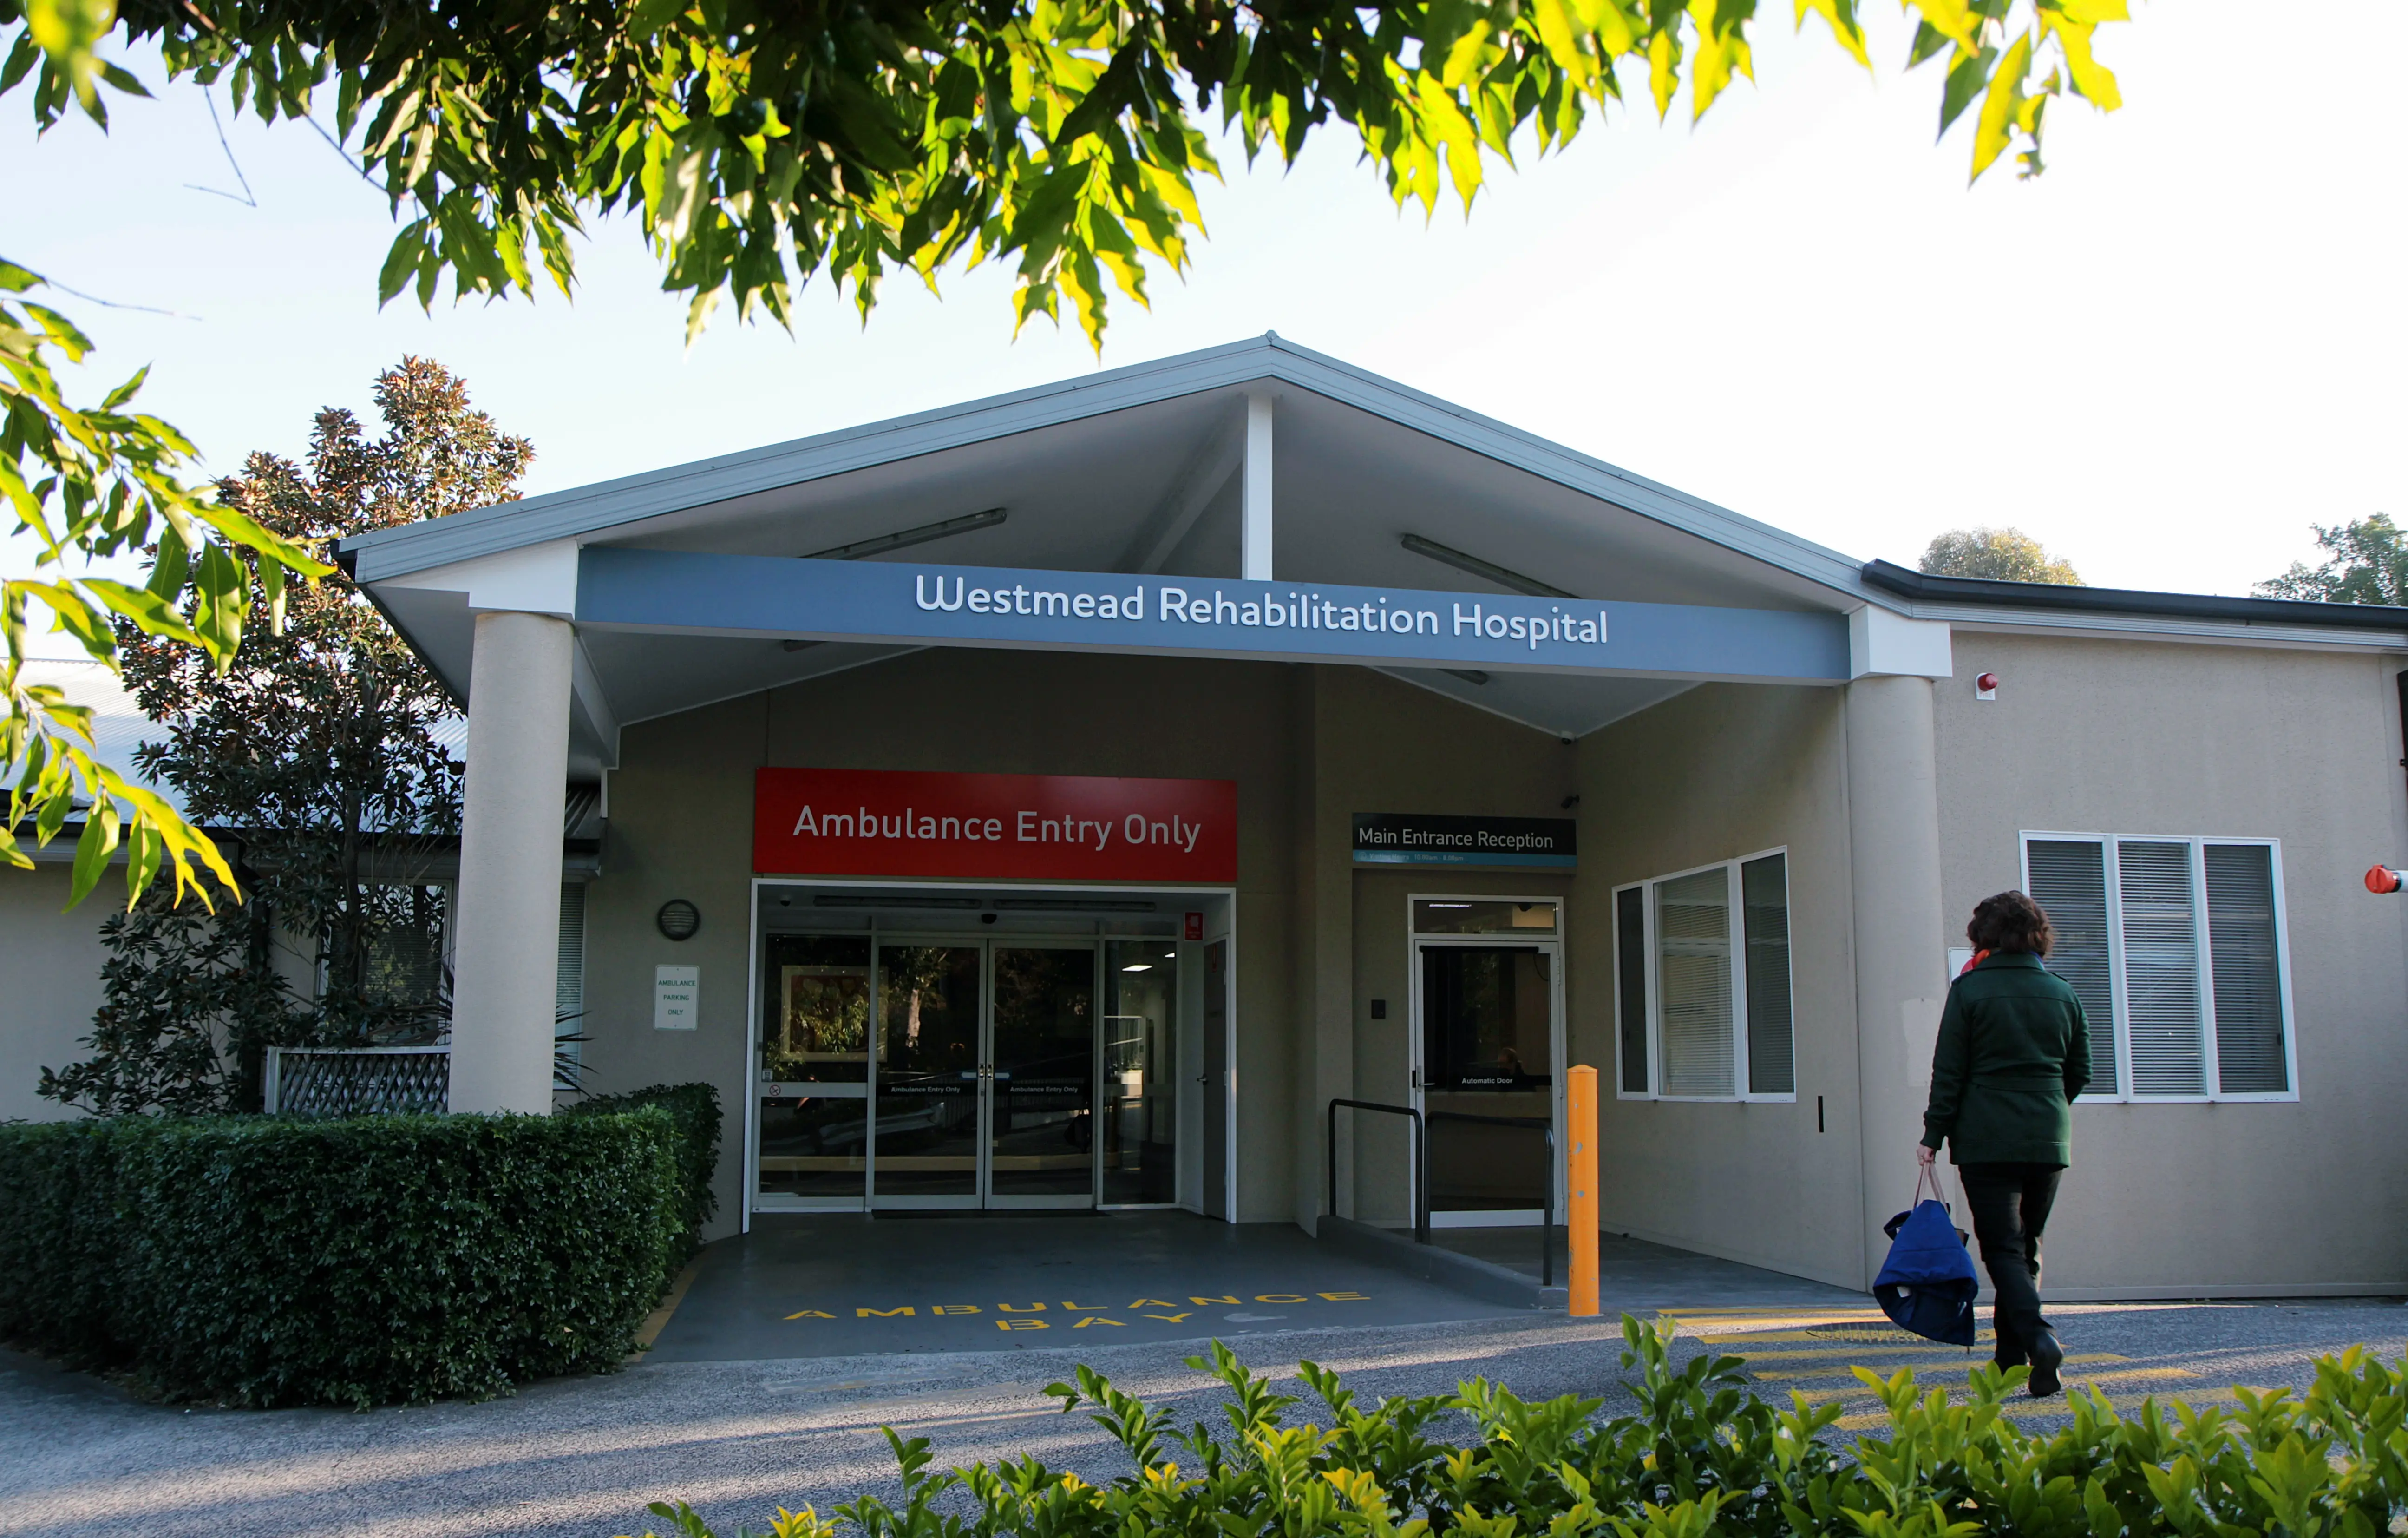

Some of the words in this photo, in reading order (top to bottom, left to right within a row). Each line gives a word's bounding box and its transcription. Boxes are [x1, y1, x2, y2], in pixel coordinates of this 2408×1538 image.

[916, 574, 1144, 620] Westmead
[1159, 587, 1439, 635] Rehabilitation
[1453, 602, 1608, 650] Hospital
[792, 804, 1002, 841] Ambulance
[1016, 810, 1113, 852] Entry
[1124, 813, 1201, 853] Only
[1359, 827, 1397, 844] Main
[1402, 828, 1473, 846] Entrance
[1478, 830, 1554, 851] Reception
[784, 1291, 1371, 1320] AMBULANCE
[995, 1313, 1194, 1331] BAY
